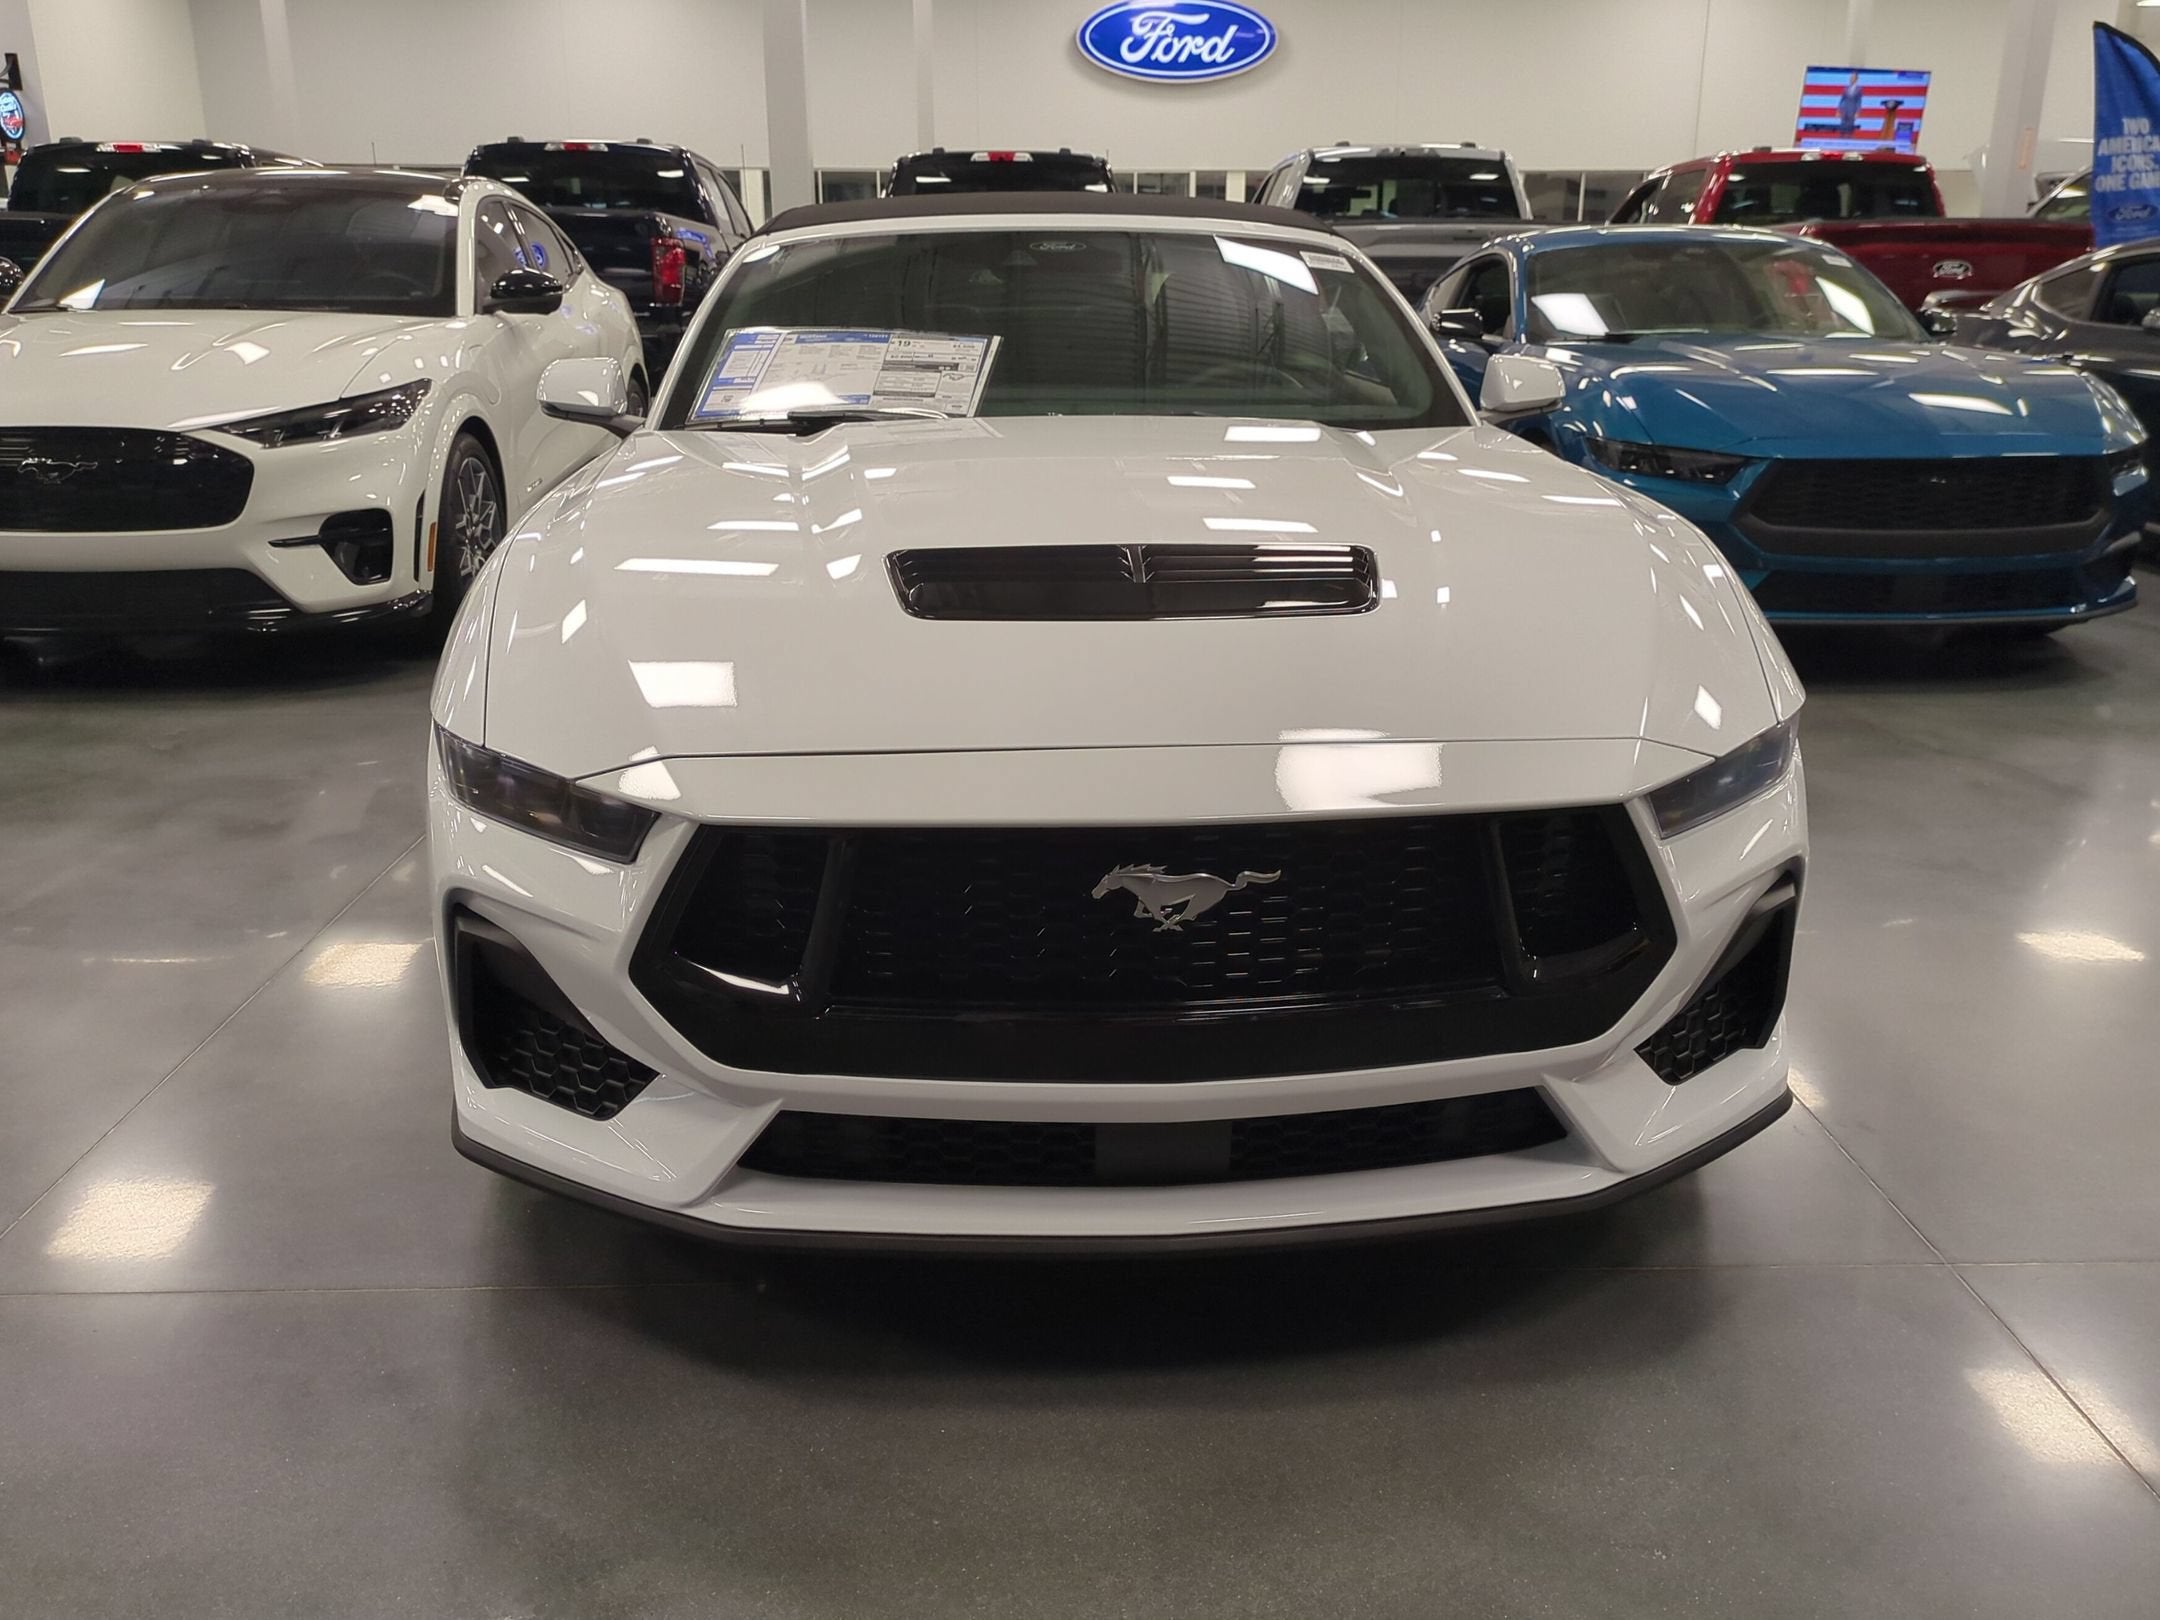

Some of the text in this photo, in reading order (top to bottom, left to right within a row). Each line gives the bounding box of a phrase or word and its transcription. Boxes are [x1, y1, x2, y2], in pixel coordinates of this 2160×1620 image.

[1120, 10, 1239, 64] Ford
[2122, 117, 2150, 135] TWO
[2097, 135, 2160, 155] AMERICA
[2095, 171, 2160, 192] ONE GAM
